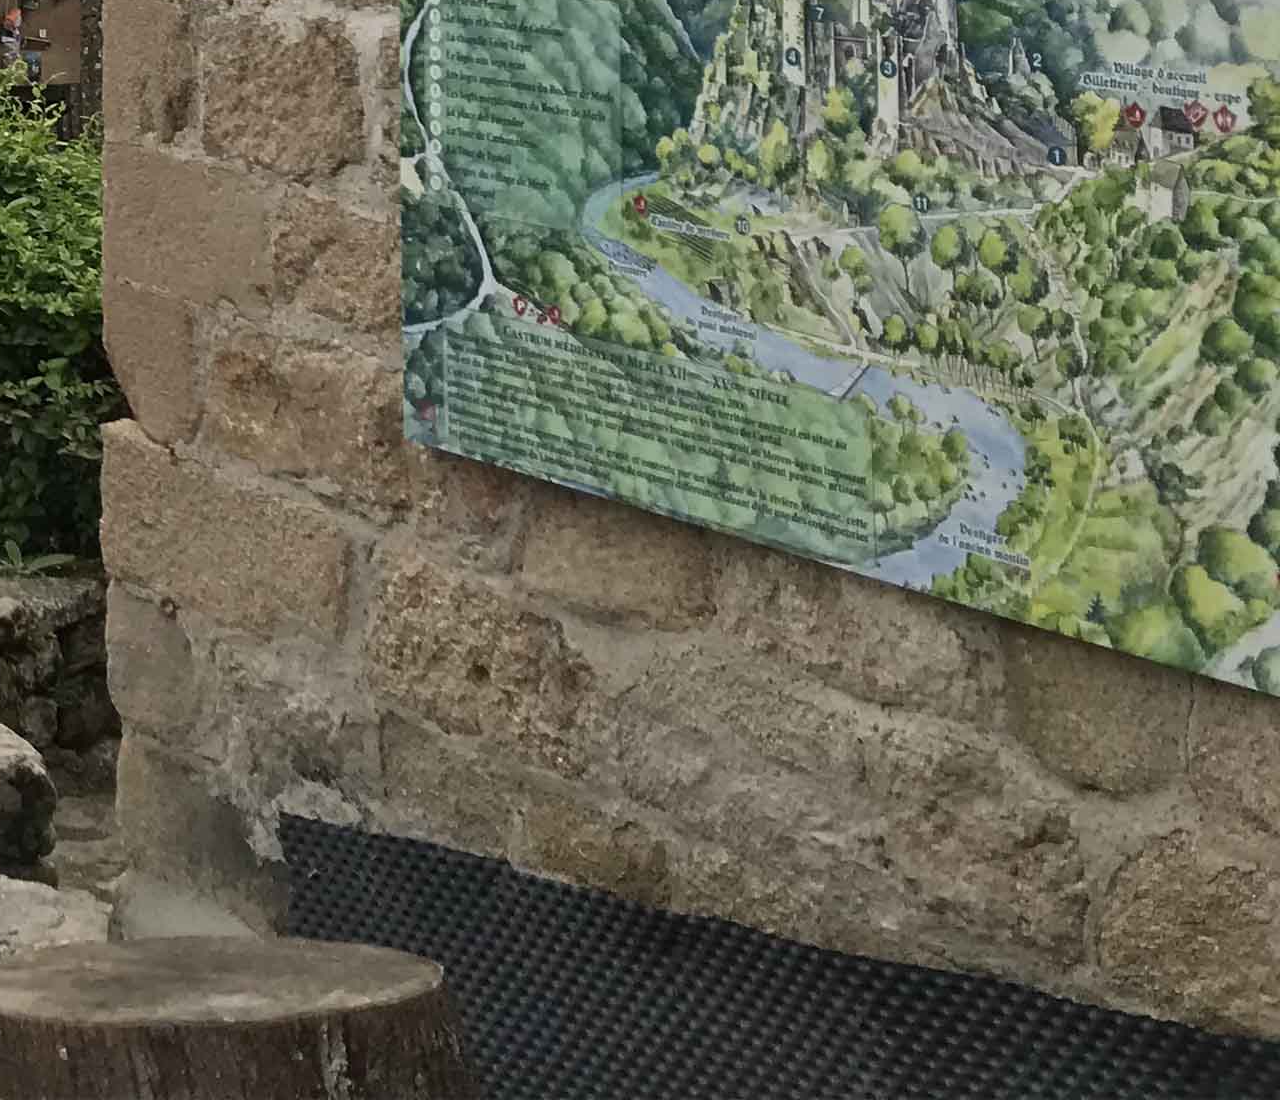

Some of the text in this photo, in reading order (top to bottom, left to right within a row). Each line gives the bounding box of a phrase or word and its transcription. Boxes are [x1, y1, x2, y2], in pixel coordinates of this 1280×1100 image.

[815, 6, 824, 19] 7
[1032, 53, 1042, 67] 2
[1113, 62, 1154, 79] Village
[1053, 150, 1061, 163] 1
[915, 196, 927, 210] 11
